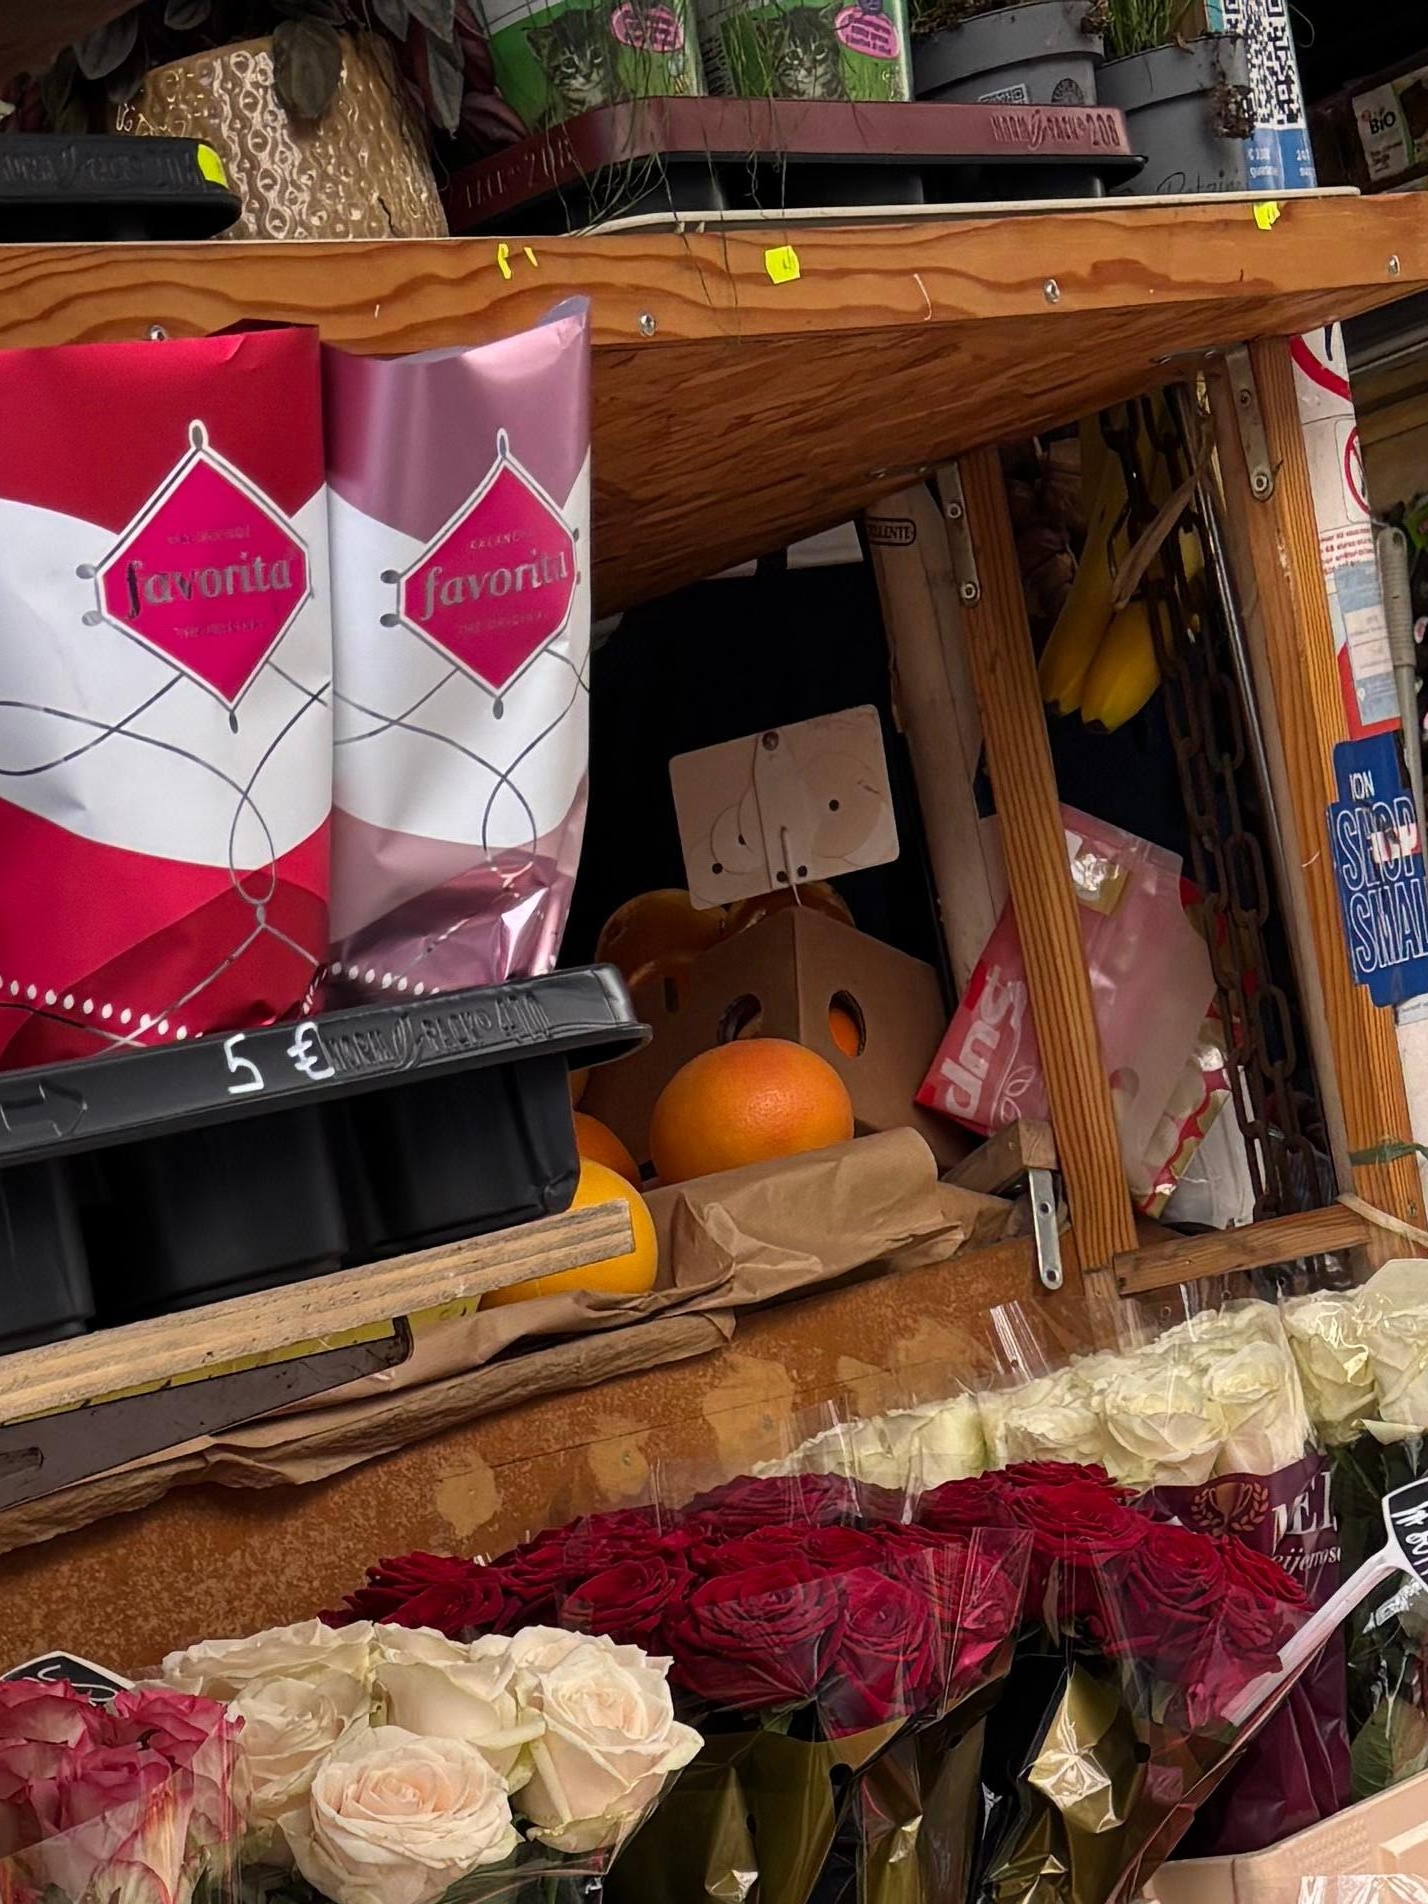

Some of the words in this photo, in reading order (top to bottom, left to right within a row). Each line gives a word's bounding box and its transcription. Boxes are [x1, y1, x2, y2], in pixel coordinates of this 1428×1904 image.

[1085, 113, 1121, 147] 208
[124, 550, 294, 620] favorita
[419, 550, 568, 622] favorita
[224, 1032, 265, 1094] 5
[286, 1021, 336, 1081] €
